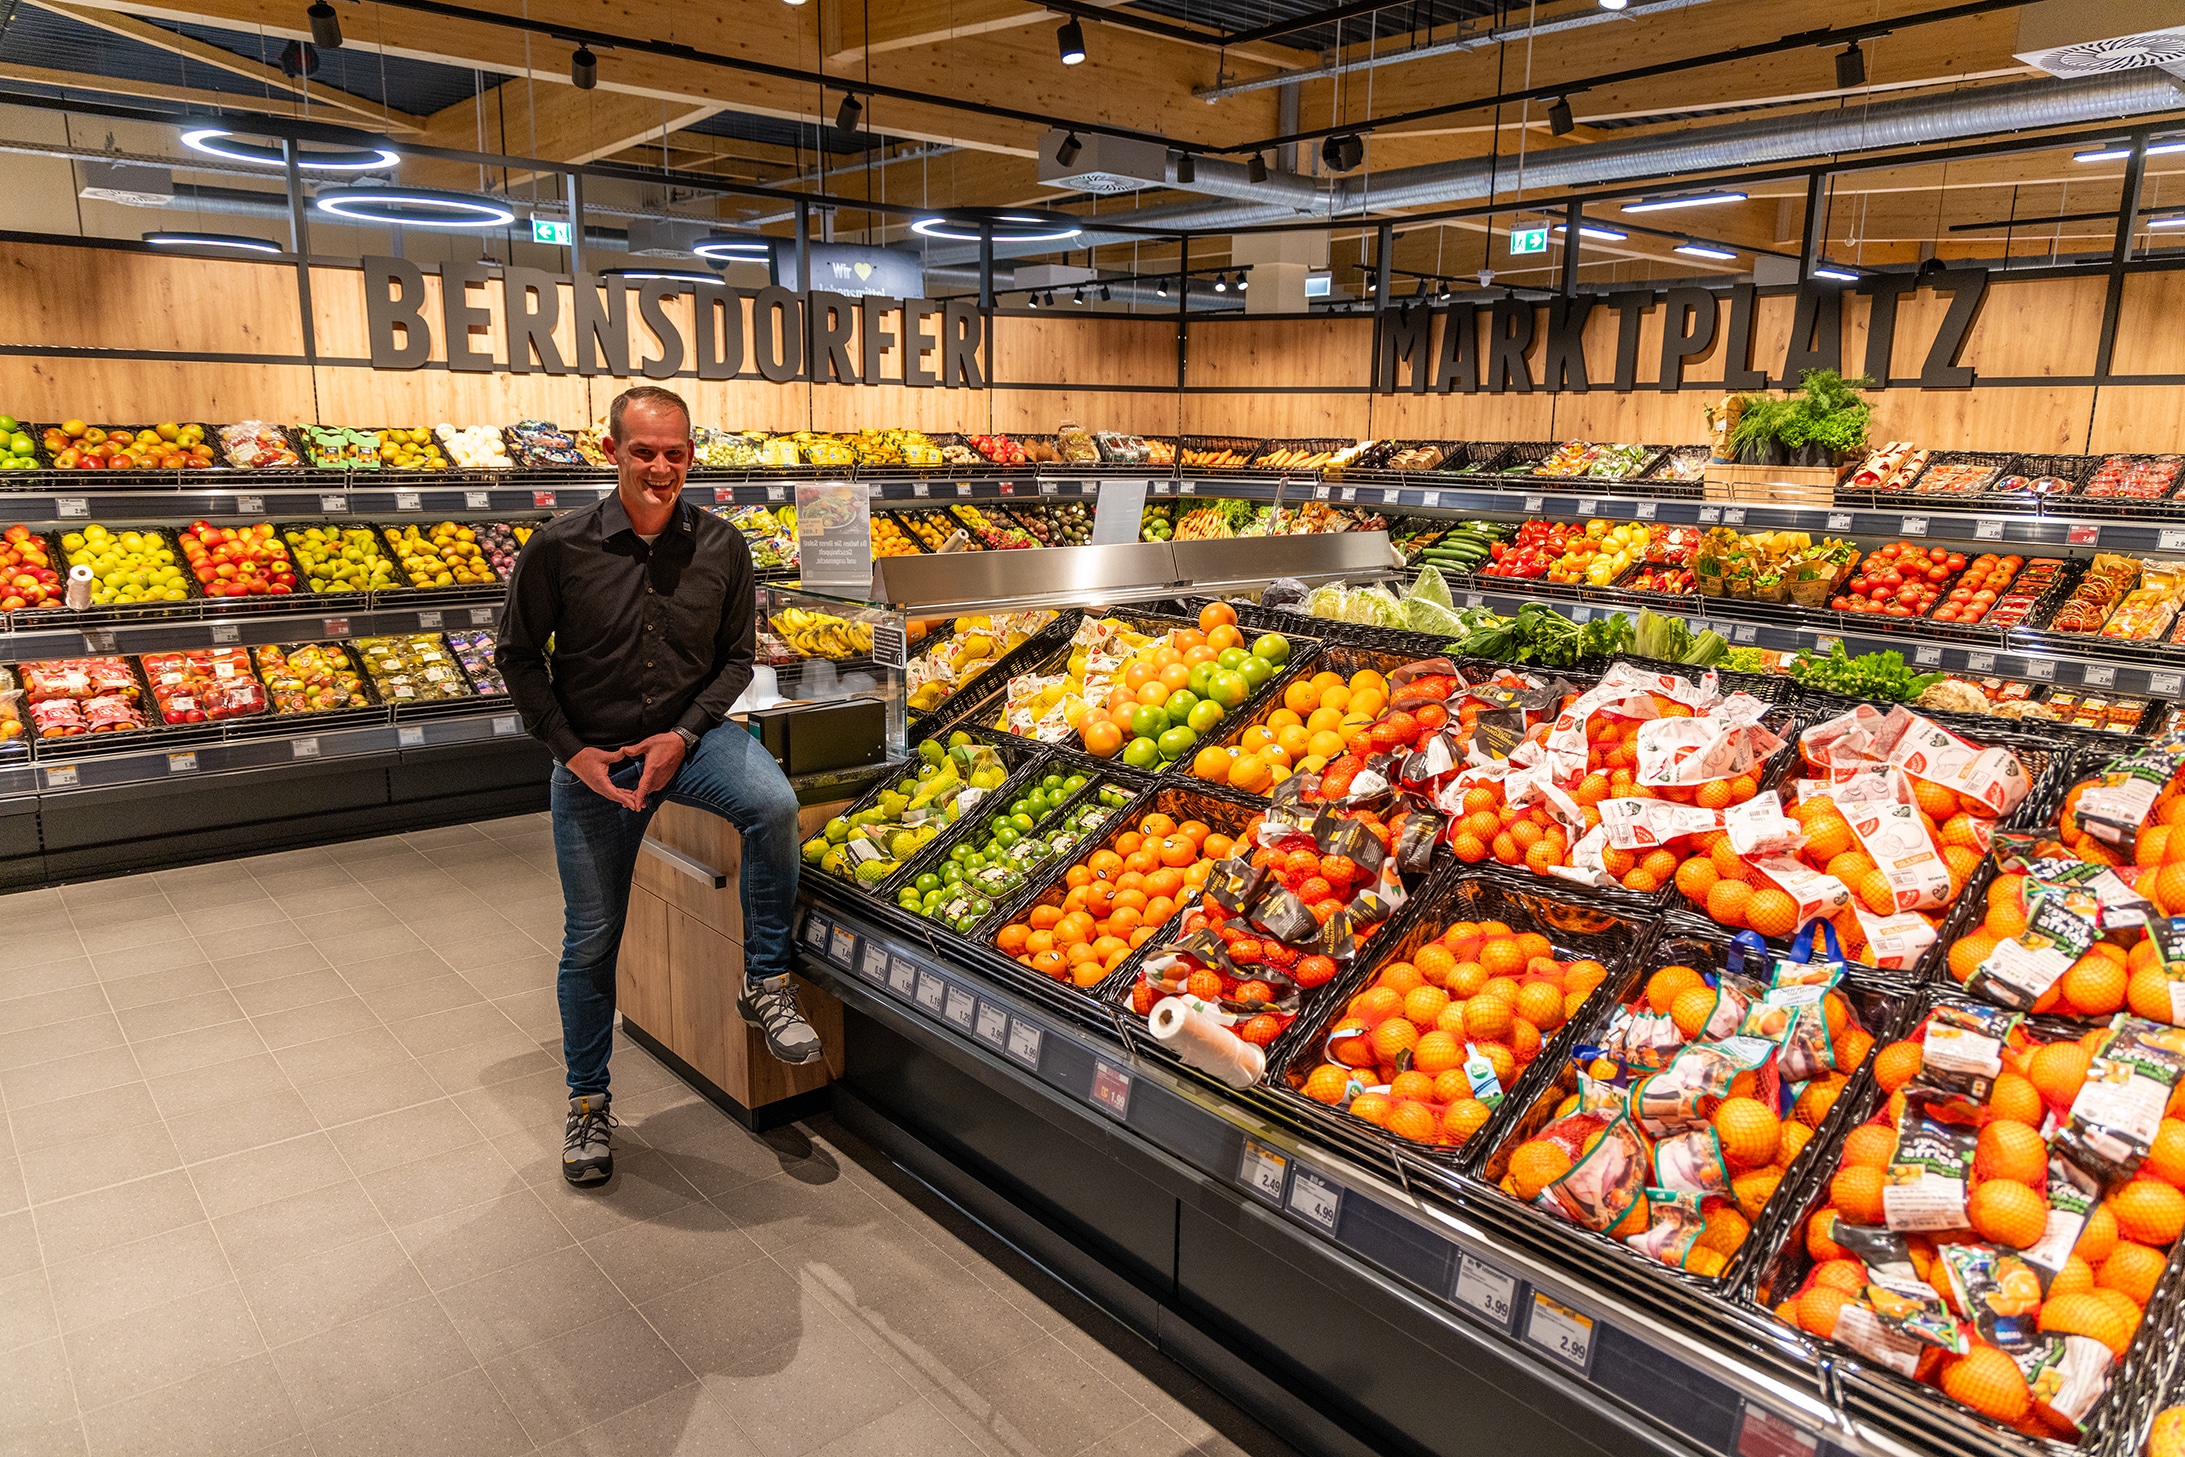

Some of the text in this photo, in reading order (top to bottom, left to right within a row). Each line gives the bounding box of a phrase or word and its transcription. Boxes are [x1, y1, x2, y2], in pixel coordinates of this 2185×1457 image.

[832, 262, 852, 279] Wir
[363, 255, 985, 389] BERNSDORFER
[1380, 267, 1990, 393] MARKTPLATZ
[1792, 584, 1808, 594] Bio
[2098, 675, 2112, 684] 2.99
[2165, 684, 2179, 692] 2.49
[1480, 723, 1518, 747] MANDARINEN
[2036, 913, 2091, 949] africa
[1023, 1044, 1037, 1058] 3.99
[1110, 1091, 1126, 1108] 1.99
[1901, 1145, 1964, 1169] africa
[1912, 1137, 1956, 1159] sweet
[1262, 1174, 1280, 1193] 2.49
[1314, 1203, 1334, 1222] 4.99
[1484, 1294, 1509, 1317] 3.99
[1559, 1335, 1586, 1360] 2.99
